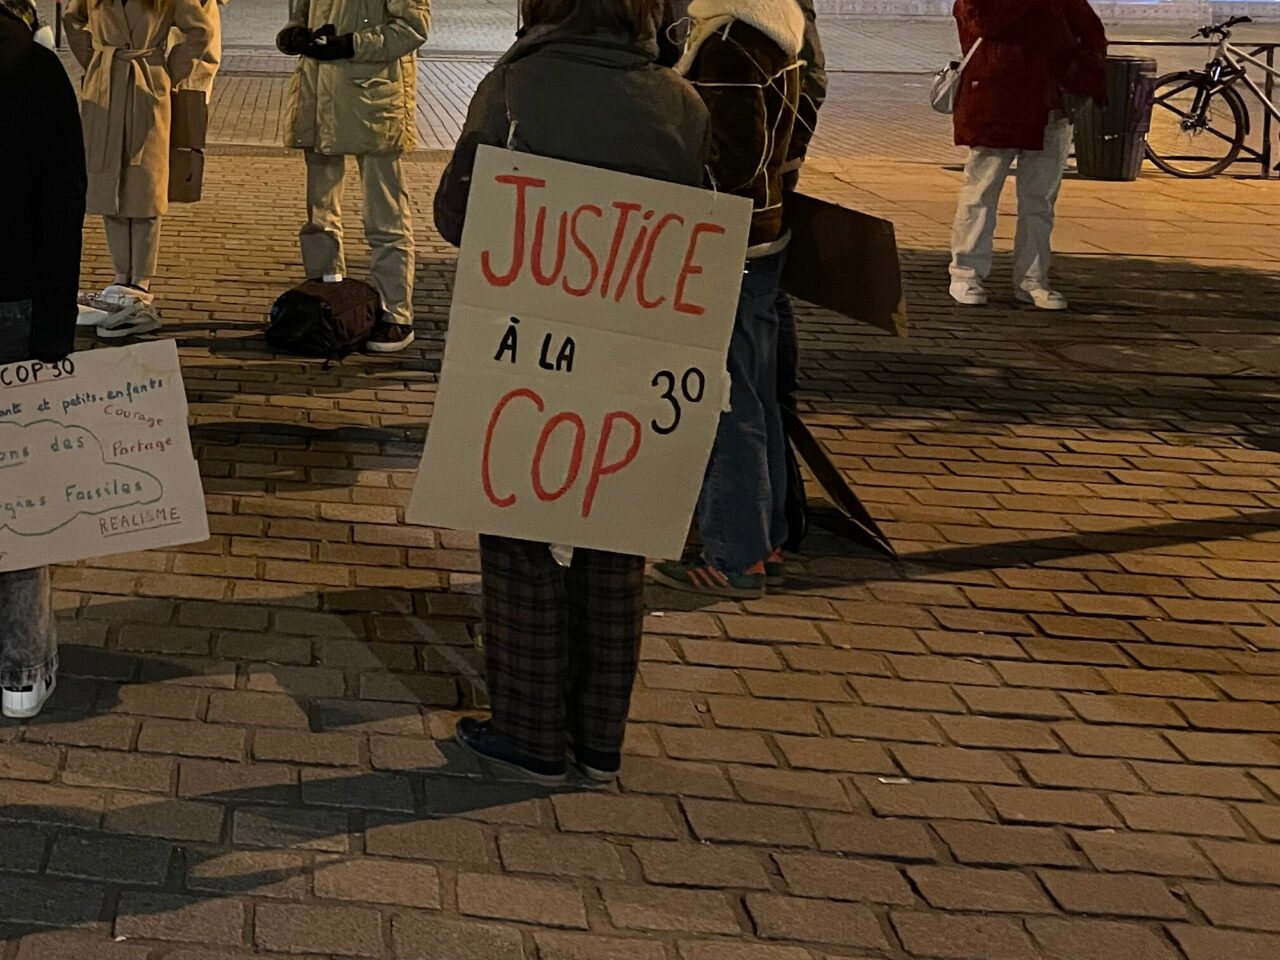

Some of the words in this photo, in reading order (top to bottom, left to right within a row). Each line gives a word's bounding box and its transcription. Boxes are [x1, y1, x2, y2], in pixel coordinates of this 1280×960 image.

[493, 316, 520, 363] À
[538, 332, 576, 373] LA
[37, 398, 51, 411] et
[103, 404, 164, 428] Courage
[50, 436, 84, 452] des
[112, 436, 174, 457] Partage
[481, 388, 642, 518] COP
[65, 479, 144, 502] Fossiles
